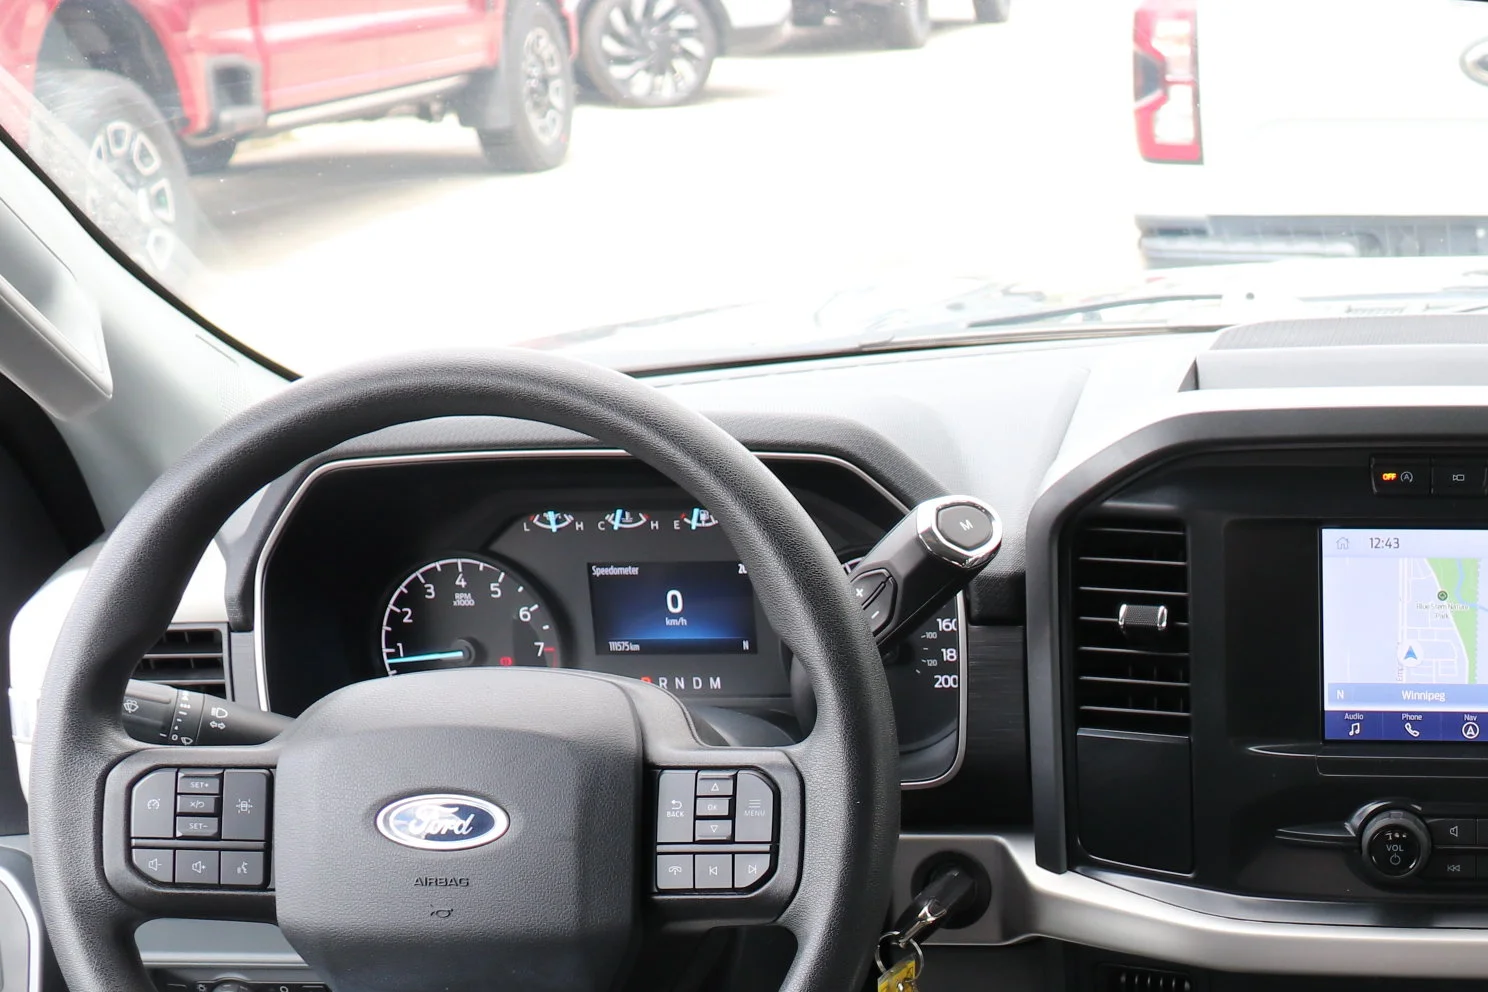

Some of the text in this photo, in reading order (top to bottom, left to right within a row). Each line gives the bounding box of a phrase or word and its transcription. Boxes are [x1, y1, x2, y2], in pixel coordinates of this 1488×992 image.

[1382, 473, 1397, 481] OFF
[523, 522, 530, 532] L
[575, 522, 584, 531] H
[597, 522, 606, 531] C
[650, 521, 659, 530] H
[673, 520, 681, 529] E
[959, 519, 974, 532] M
[1369, 537, 1400, 550] 12:43
[591, 565, 639, 577] Speedometer
[455, 573, 467, 588] 4
[424, 584, 436, 599] 3
[454, 592, 472, 600] RPM
[490, 583, 502, 598] 5
[666, 589, 683, 614] 0
[402, 608, 413, 623] 2
[519, 606, 531, 622] 6
[665, 617, 688, 626] km/h
[534, 641, 545, 657] 7
[658, 677, 668, 690] R
[675, 676, 685, 690] N
[692, 676, 702, 690] D
[709, 676, 722, 690] M
[934, 675, 959, 688] 200
[1336, 689, 1345, 700] N
[1401, 690, 1446, 702] Winnipeg
[1401, 713, 1423, 721] Phone
[666, 810, 685, 818] BACK
[409, 803, 476, 840] Ford
[1385, 844, 1404, 852] VOL
[413, 876, 470, 887] AIRBAG
